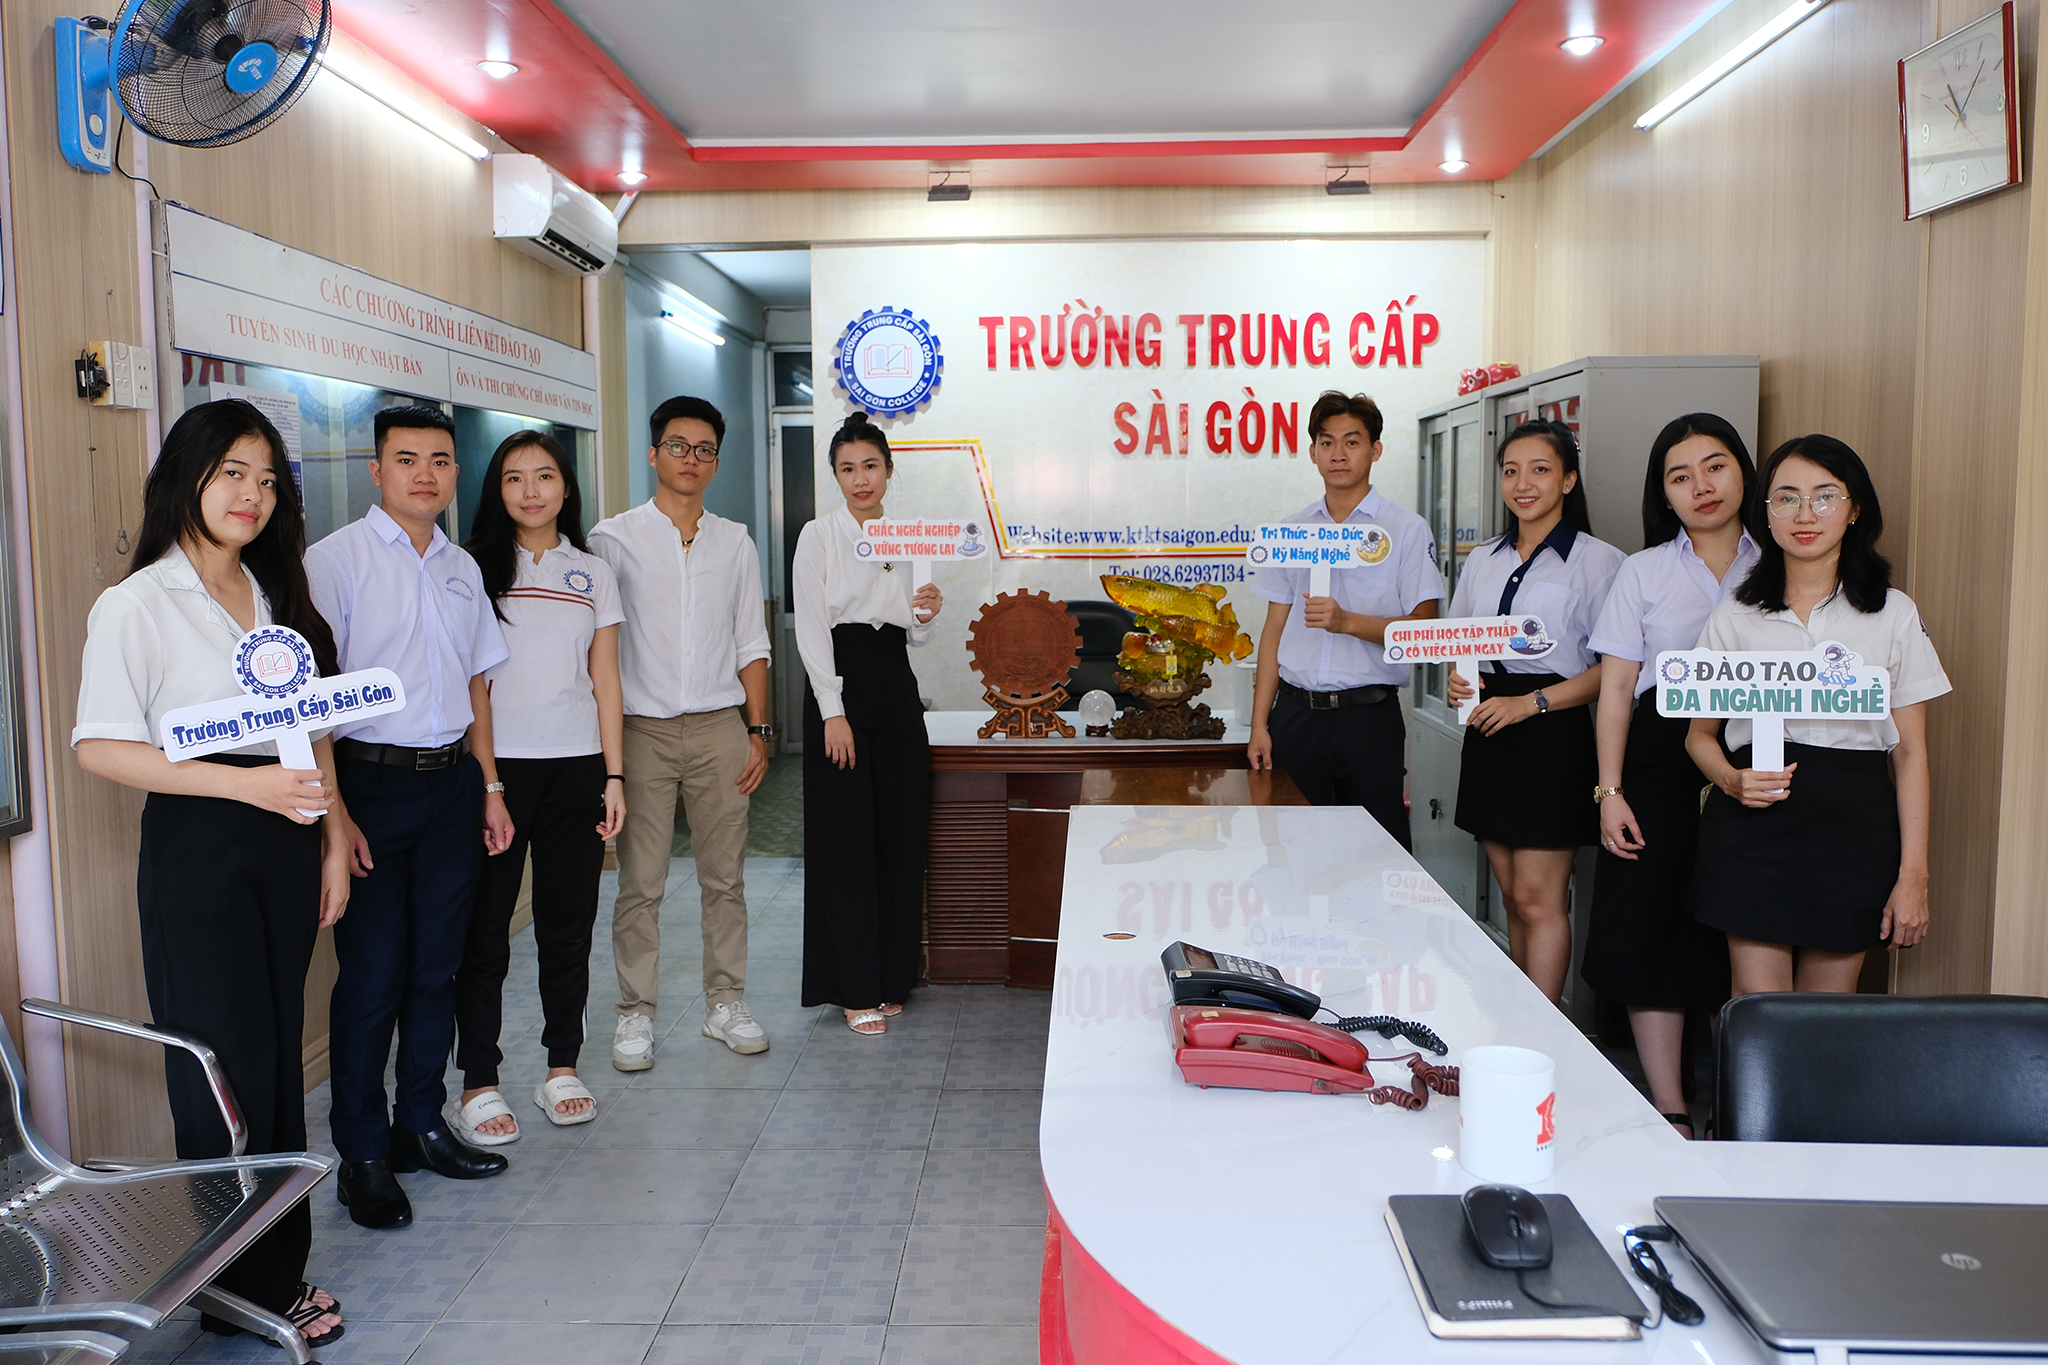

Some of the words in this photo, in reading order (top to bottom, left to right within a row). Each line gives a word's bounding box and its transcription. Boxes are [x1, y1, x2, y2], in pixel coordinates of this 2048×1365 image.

[1922, 123, 1930, 144] 9
[1960, 165, 1968, 186] 6
[320, 274, 353, 309] CÁC
[356, 289, 415, 328] CHƯƠNG
[417, 308, 454, 340] TRÌNH
[458, 320, 482, 347] LIÊN
[484, 327, 499, 353] KẾT
[501, 333, 521, 359] ĐÀO
[522, 343, 541, 367] TẠO
[860, 316, 893, 332] TRUNG
[978, 298, 1163, 368] TRƯỜNG
[1179, 312, 1331, 367] TRUNG
[1348, 295, 1440, 368] CẤP
[226, 313, 280, 344] TUYỂN
[284, 326, 317, 352] SINH
[321, 336, 339, 357] DU
[342, 341, 368, 366] HỌC
[370, 348, 400, 373] NHẬT
[403, 354, 422, 376] BẢN
[456, 366, 469, 387] ÔN
[471, 371, 483, 391] VÀ
[485, 377, 499, 394] THI
[501, 380, 529, 400] CHỨNG
[544, 393, 558, 407] ANH
[851, 382, 866, 398] SAI
[865, 394, 886, 407] GON
[887, 380, 927, 407] COLLEGE
[1113, 388, 1189, 455] SÀI
[1205, 386, 1298, 454] GÒN
[867, 520, 894, 537] CHẮC
[896, 520, 922, 537] NGHỀ
[924, 522, 960, 538] NGHIỆP
[1007, 524, 1256, 547] Website:www.ktktsaigon.edu.
[1280, 526, 1308, 540] Thức
[1318, 527, 1339, 544] Đạo
[1341, 526, 1363, 540] Đức
[874, 541, 901, 555] VỮNG
[940, 543, 955, 555] LAI
[1272, 547, 1287, 563] Kỹ
[1290, 547, 1318, 564] Năng
[1321, 544, 1350, 565] Nghề
[1144, 564, 1245, 583] 028.62937134
[1392, 630, 1411, 642] CHI
[1413, 627, 1434, 641] PHÍ
[1436, 628, 1459, 642] HỌC
[1461, 624, 1484, 642] TẬP
[1486, 620, 1518, 638] THẤP
[1405, 645, 1420, 658] CÓ
[1423, 643, 1446, 659] VIỆC
[1449, 642, 1472, 656] LÀM
[1474, 643, 1505, 655] NGAY
[1694, 656, 1755, 682] ĐÀO
[1760, 661, 1817, 687] TẠO
[1666, 688, 1701, 712] ĐA
[1710, 683, 1801, 712] NGÀNH
[1811, 677, 1884, 713] NGHỀ
[172, 717, 240, 746] Trường
[242, 706, 296, 729] Trung
[297, 693, 330, 719] Cấp
[334, 688, 359, 710] Sài
[362, 681, 393, 702] Gòn
